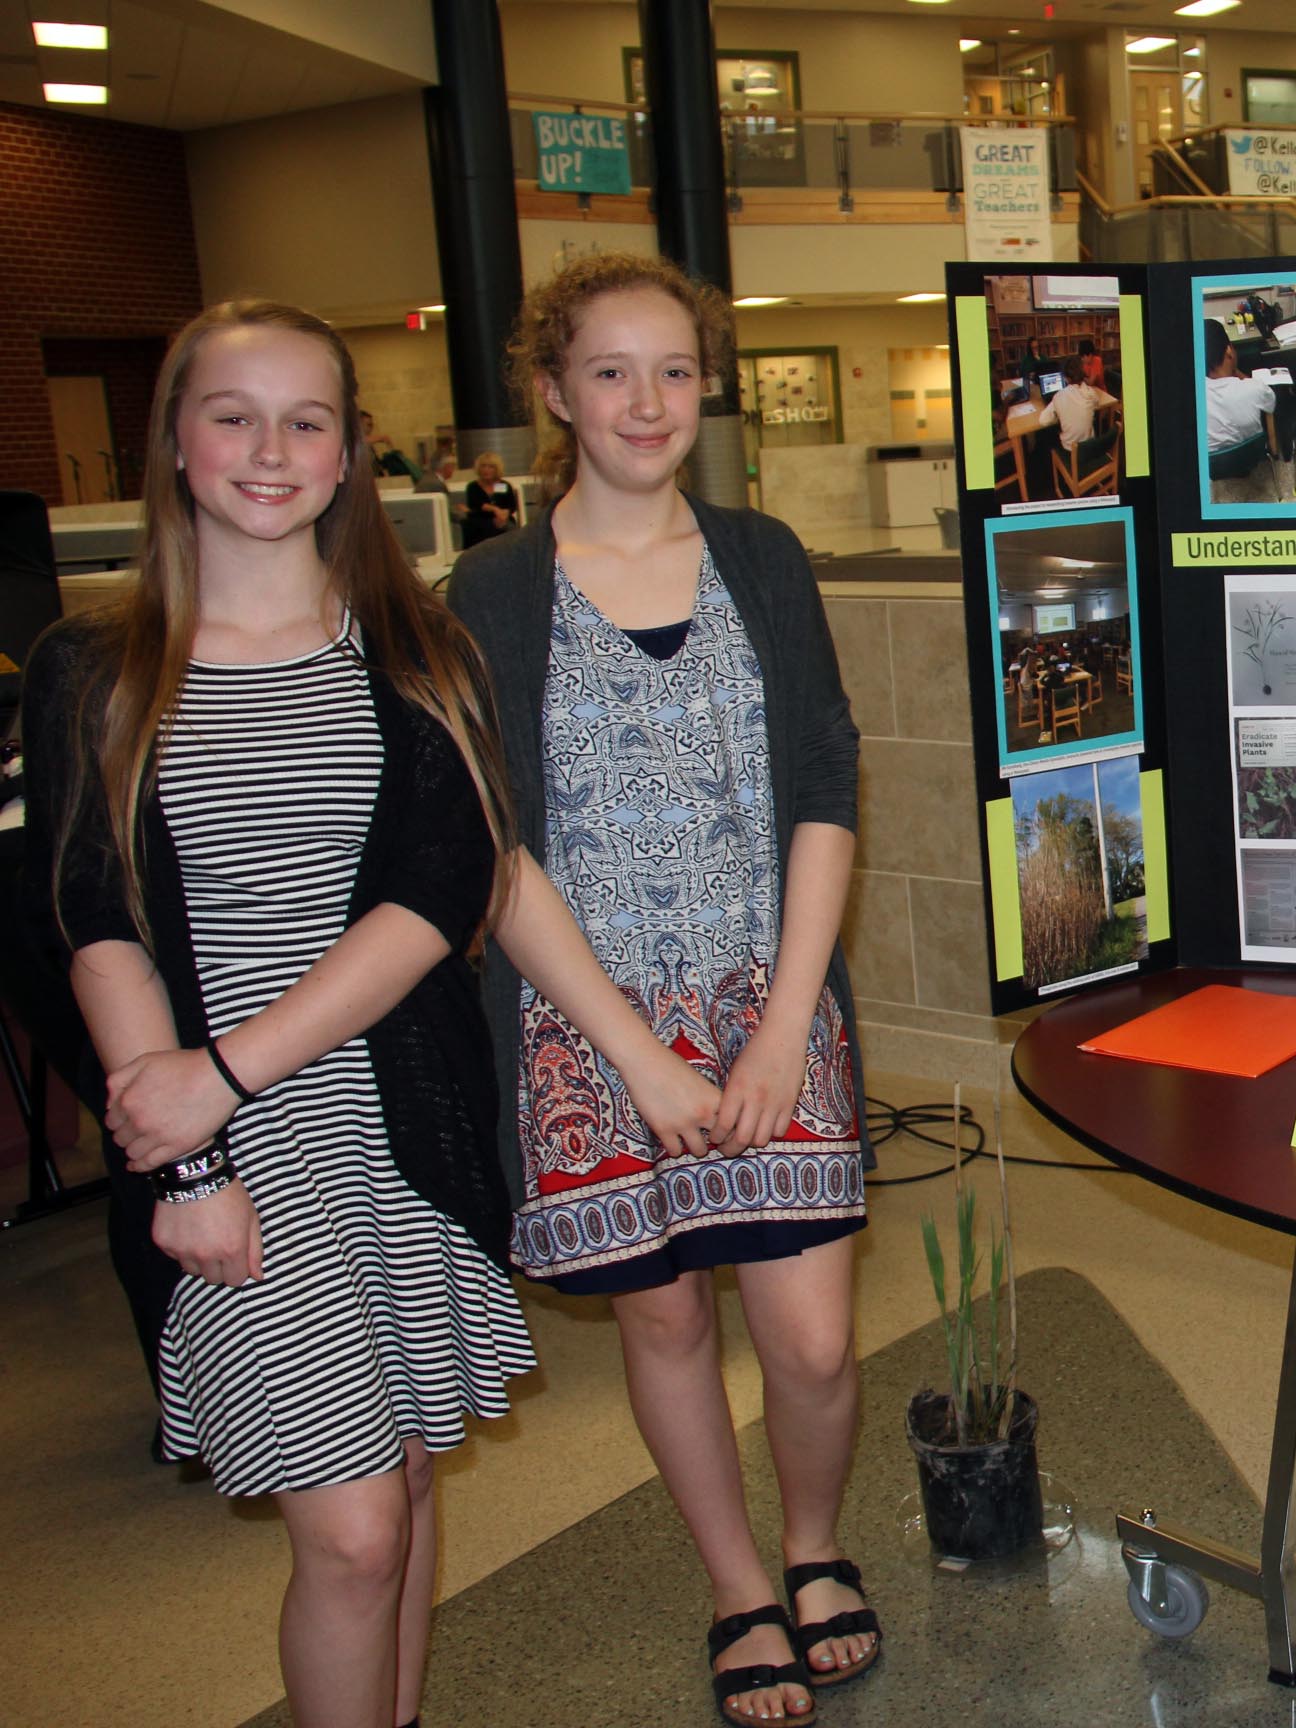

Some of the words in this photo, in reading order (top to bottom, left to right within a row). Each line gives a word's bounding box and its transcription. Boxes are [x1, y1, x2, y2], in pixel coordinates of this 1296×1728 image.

[537, 115, 624, 149] BUCKLE
[975, 144, 1034, 163] GREAT
[541, 150, 582, 184] UP!
[974, 183, 1038, 200] GREAT
[974, 199, 1039, 213] Teachers
[1242, 740, 1274, 748] Invasive
